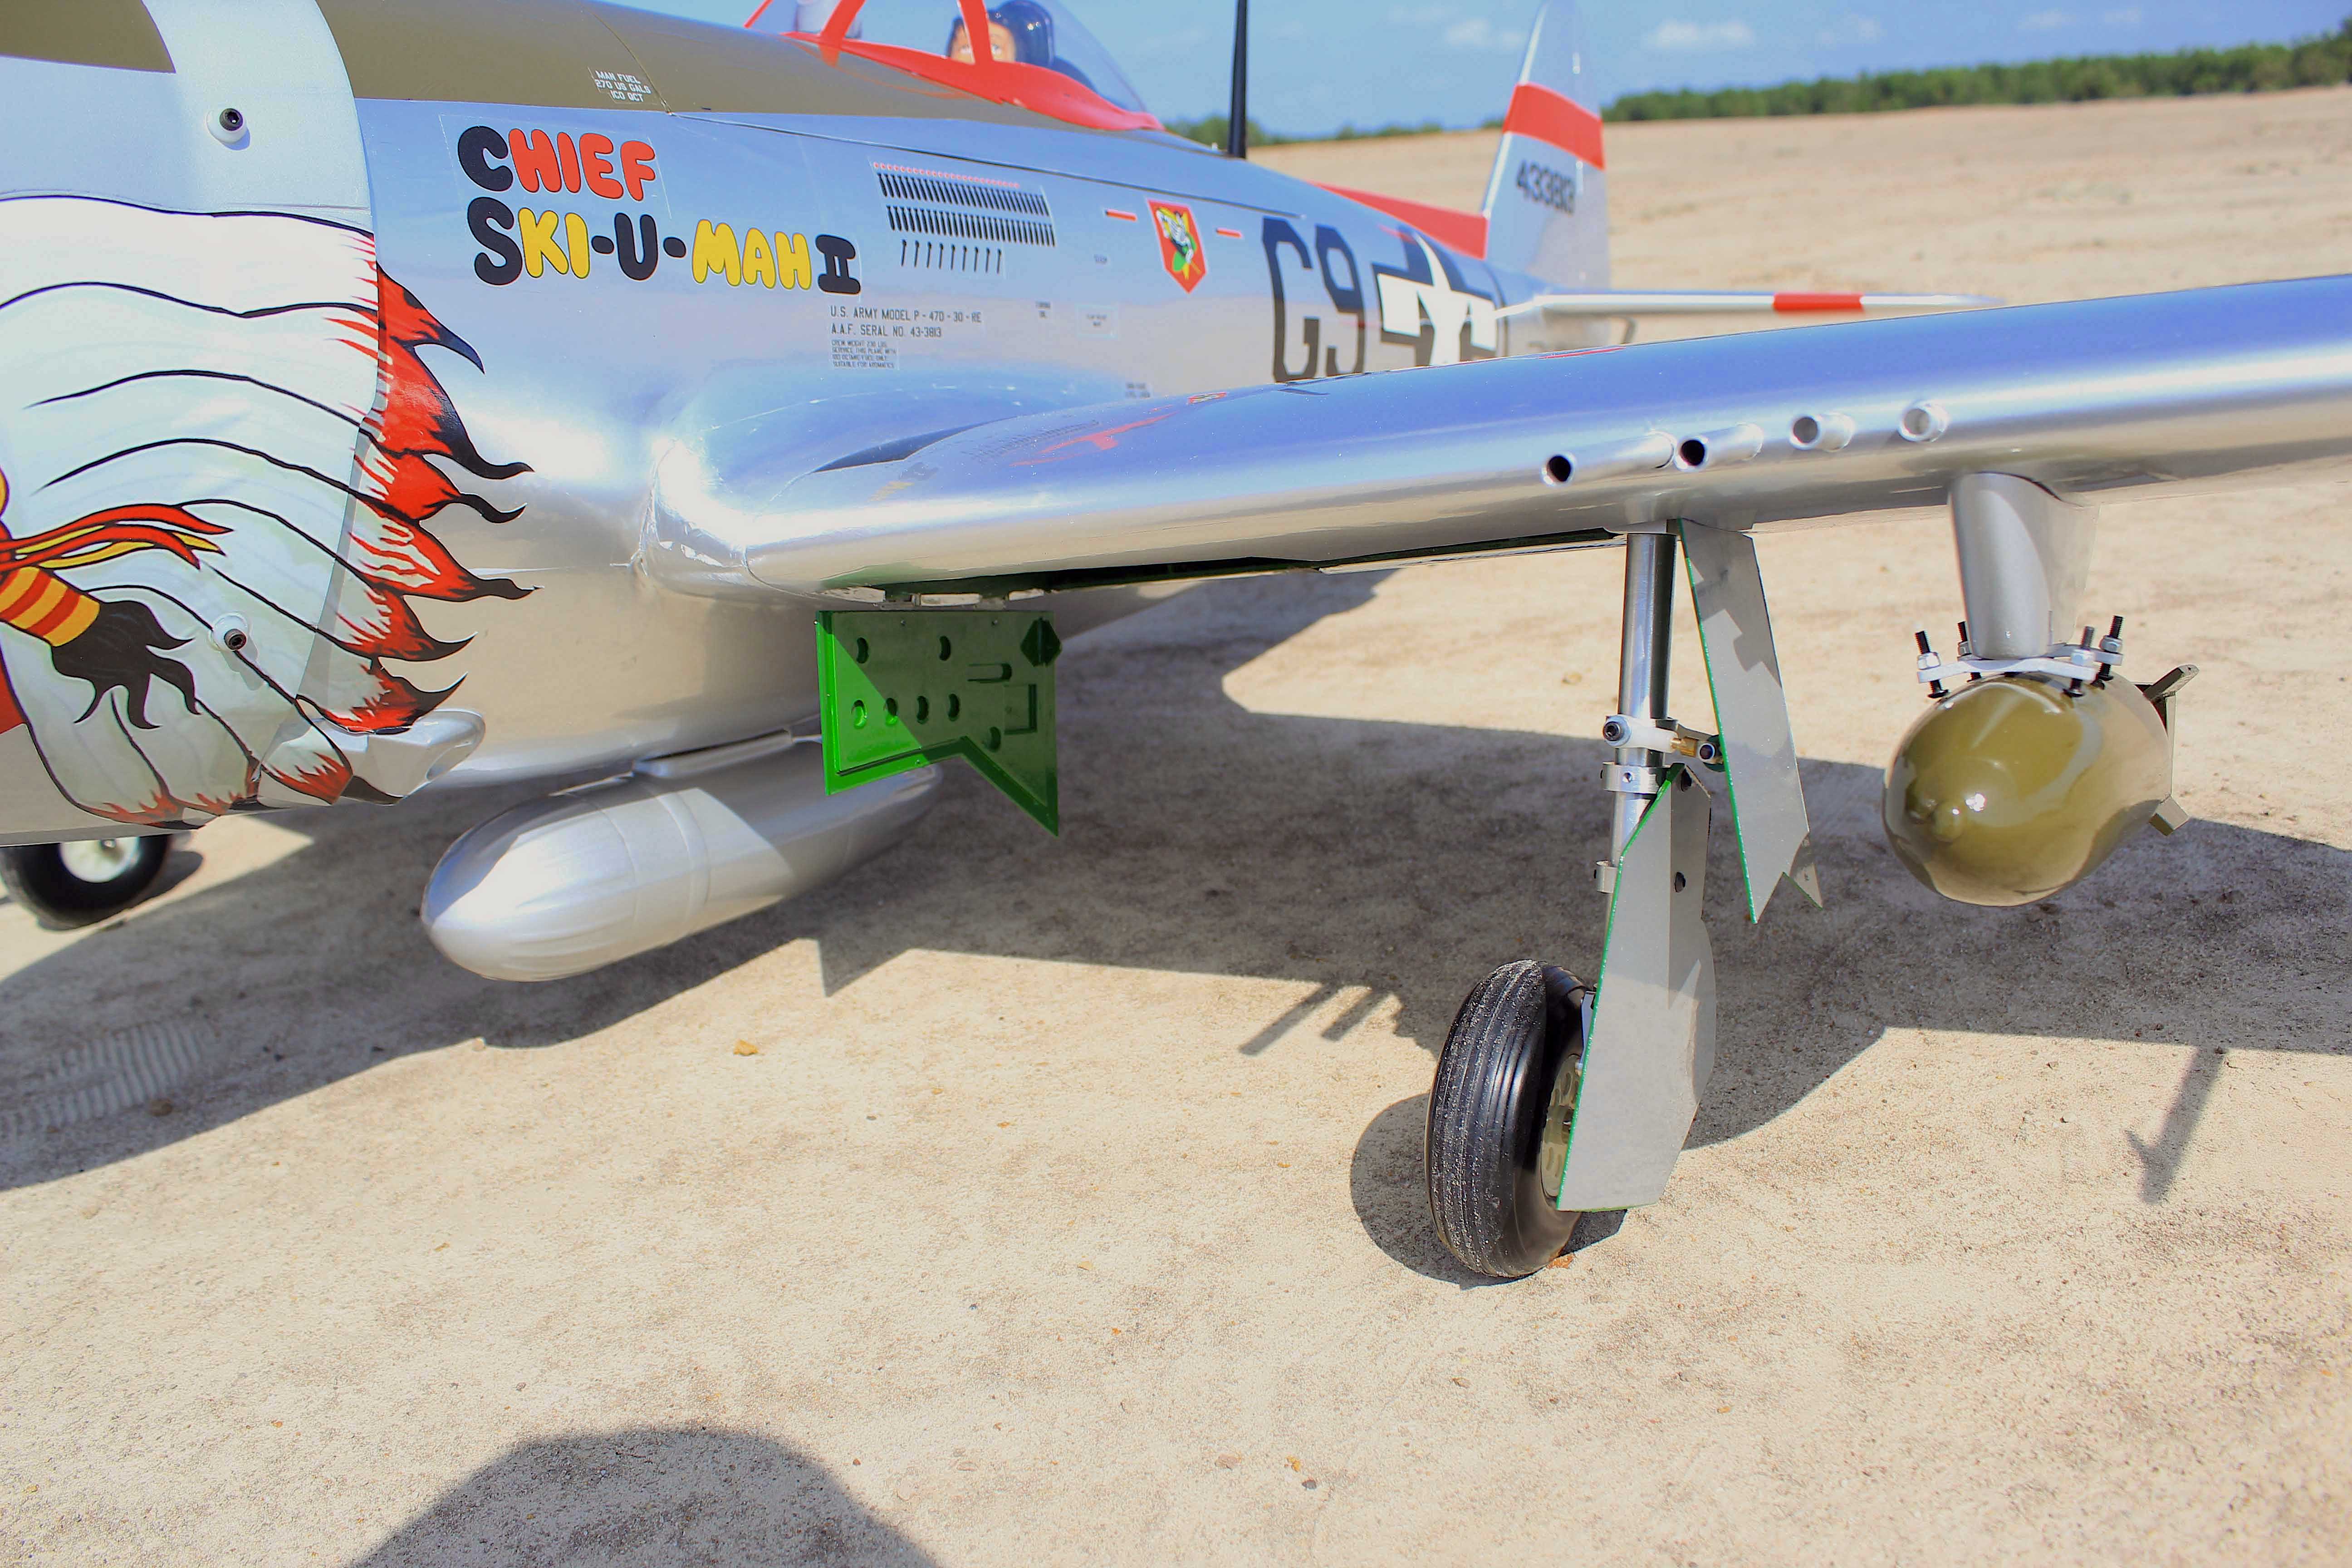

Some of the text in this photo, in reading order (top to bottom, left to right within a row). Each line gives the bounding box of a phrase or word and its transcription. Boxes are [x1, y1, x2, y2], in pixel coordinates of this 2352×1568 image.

[595, 79, 652, 94] 270 US GALS
[617, 74, 641, 84] FUEL
[457, 125, 656, 201] CHIEF
[467, 196, 812, 290] SKI-U-MAH
[830, 305, 848, 317] U.S.
[853, 307, 877, 319] ARMY
[881, 309, 910, 321] MODEL
[831, 323, 856, 335] A.A.F.
[860, 324, 888, 336] SERAL
